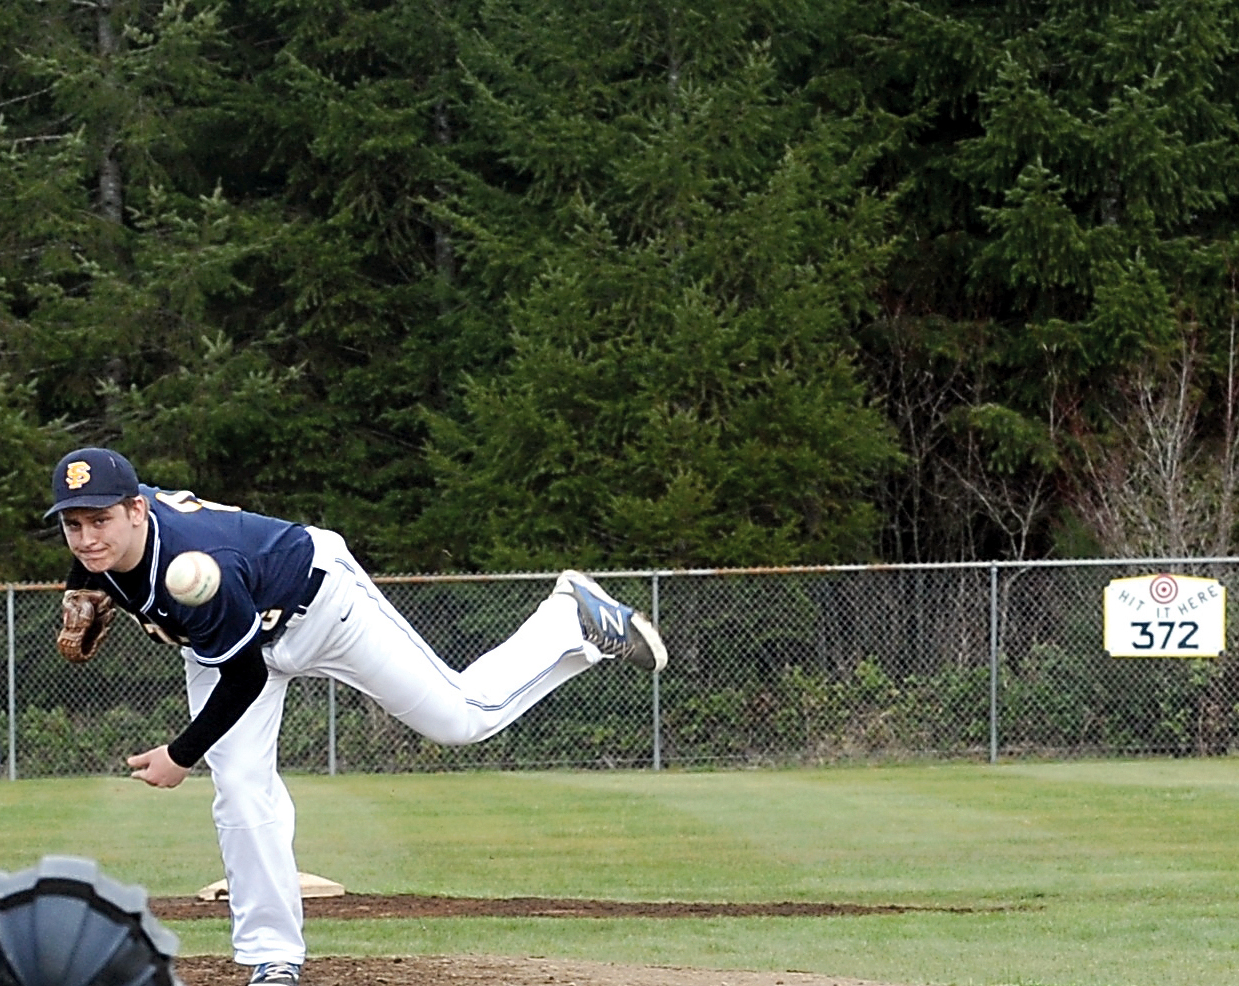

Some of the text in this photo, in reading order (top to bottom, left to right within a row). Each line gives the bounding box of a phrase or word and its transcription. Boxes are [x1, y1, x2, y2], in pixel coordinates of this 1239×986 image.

[1118, 585, 1218, 618] HIT IT HERE
[1130, 621, 1199, 650] 372
